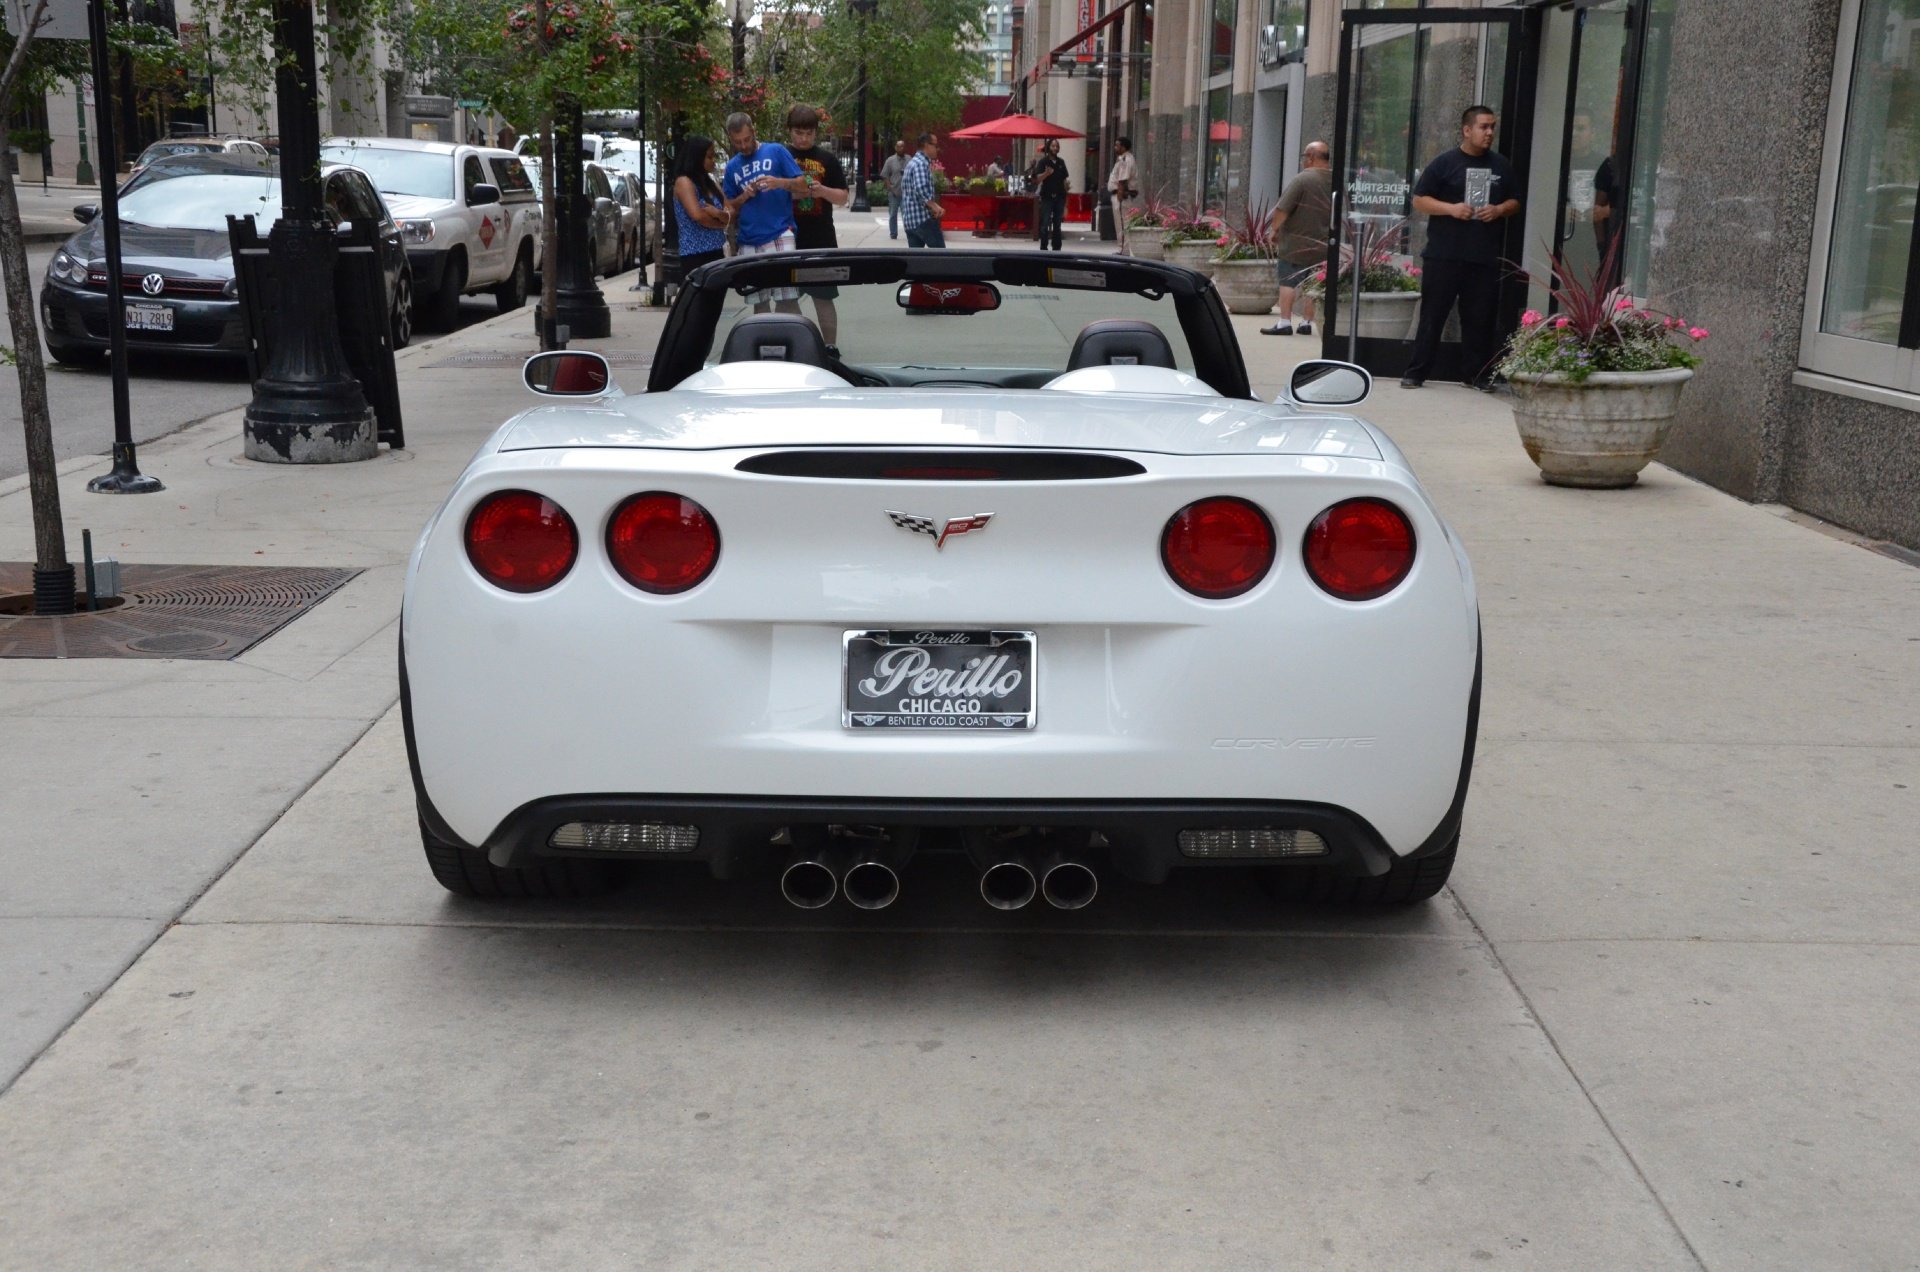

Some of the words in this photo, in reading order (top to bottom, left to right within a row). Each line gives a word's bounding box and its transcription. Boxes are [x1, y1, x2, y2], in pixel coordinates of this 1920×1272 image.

[734, 158, 772, 186] AERO
[909, 631, 970, 645] Perillo
[858, 646, 1022, 698] Perillo
[898, 698, 981, 713] CHICAGO
[888, 716, 927, 726] BENTLEY
[929, 715, 956, 726] GOLD
[958, 715, 990, 726] COAST
[1210, 736, 1376, 749] CORVETTE
